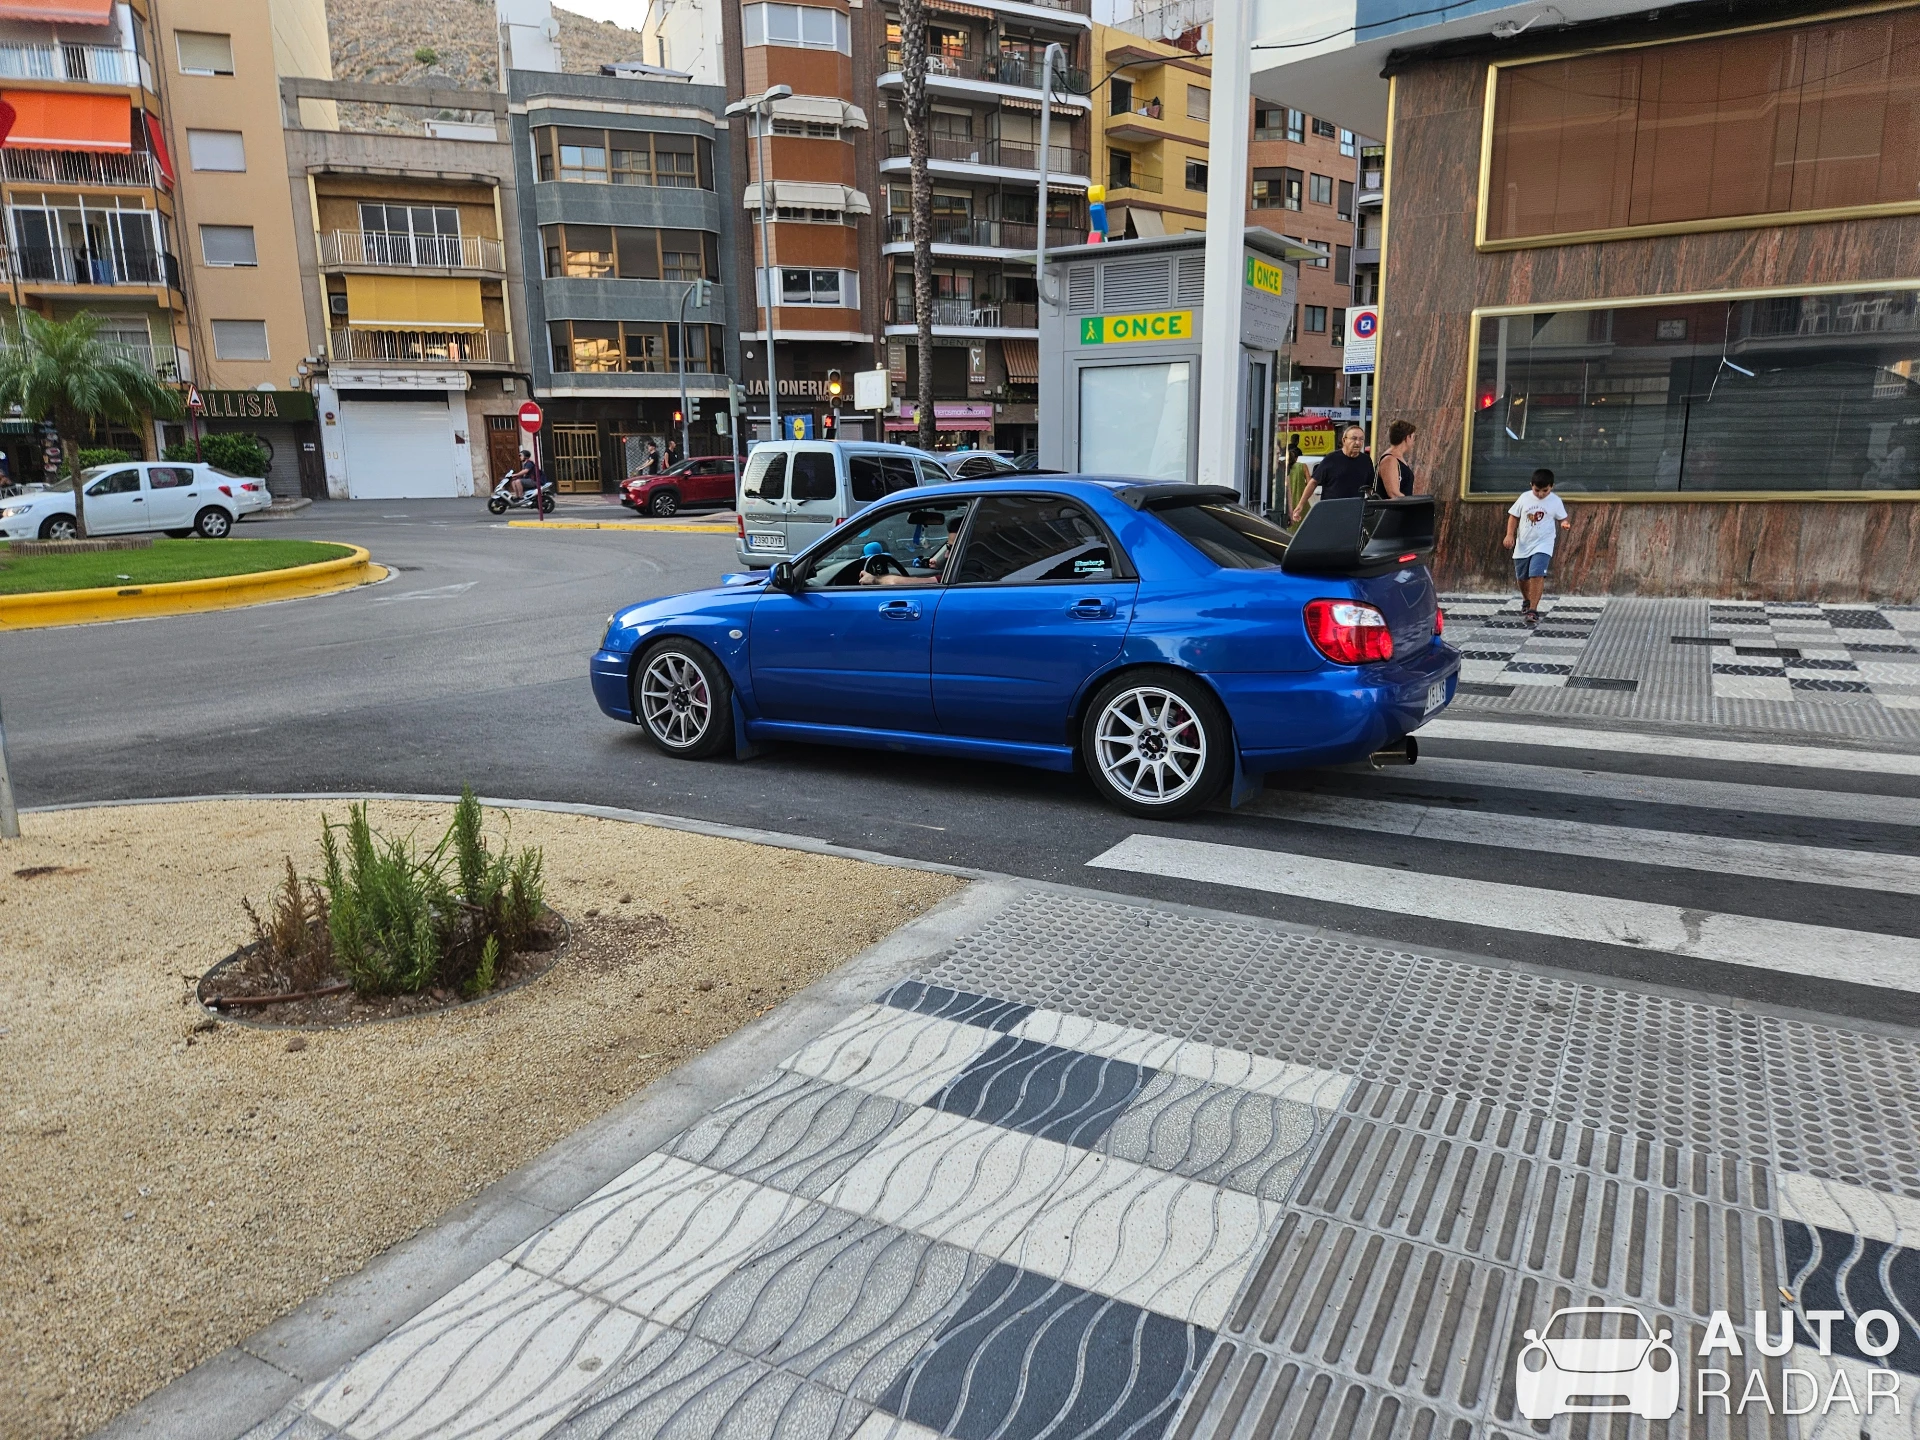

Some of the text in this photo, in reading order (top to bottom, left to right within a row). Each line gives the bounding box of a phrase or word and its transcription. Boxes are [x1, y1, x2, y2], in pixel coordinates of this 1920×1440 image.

[1257, 265, 1280, 292] ONCE
[1112, 315, 1182, 338] ONCE
[940, 338, 985, 348] DENTAL
[1304, 435, 1325, 447] SVA
[754, 534, 783, 546] 2390 DYR
